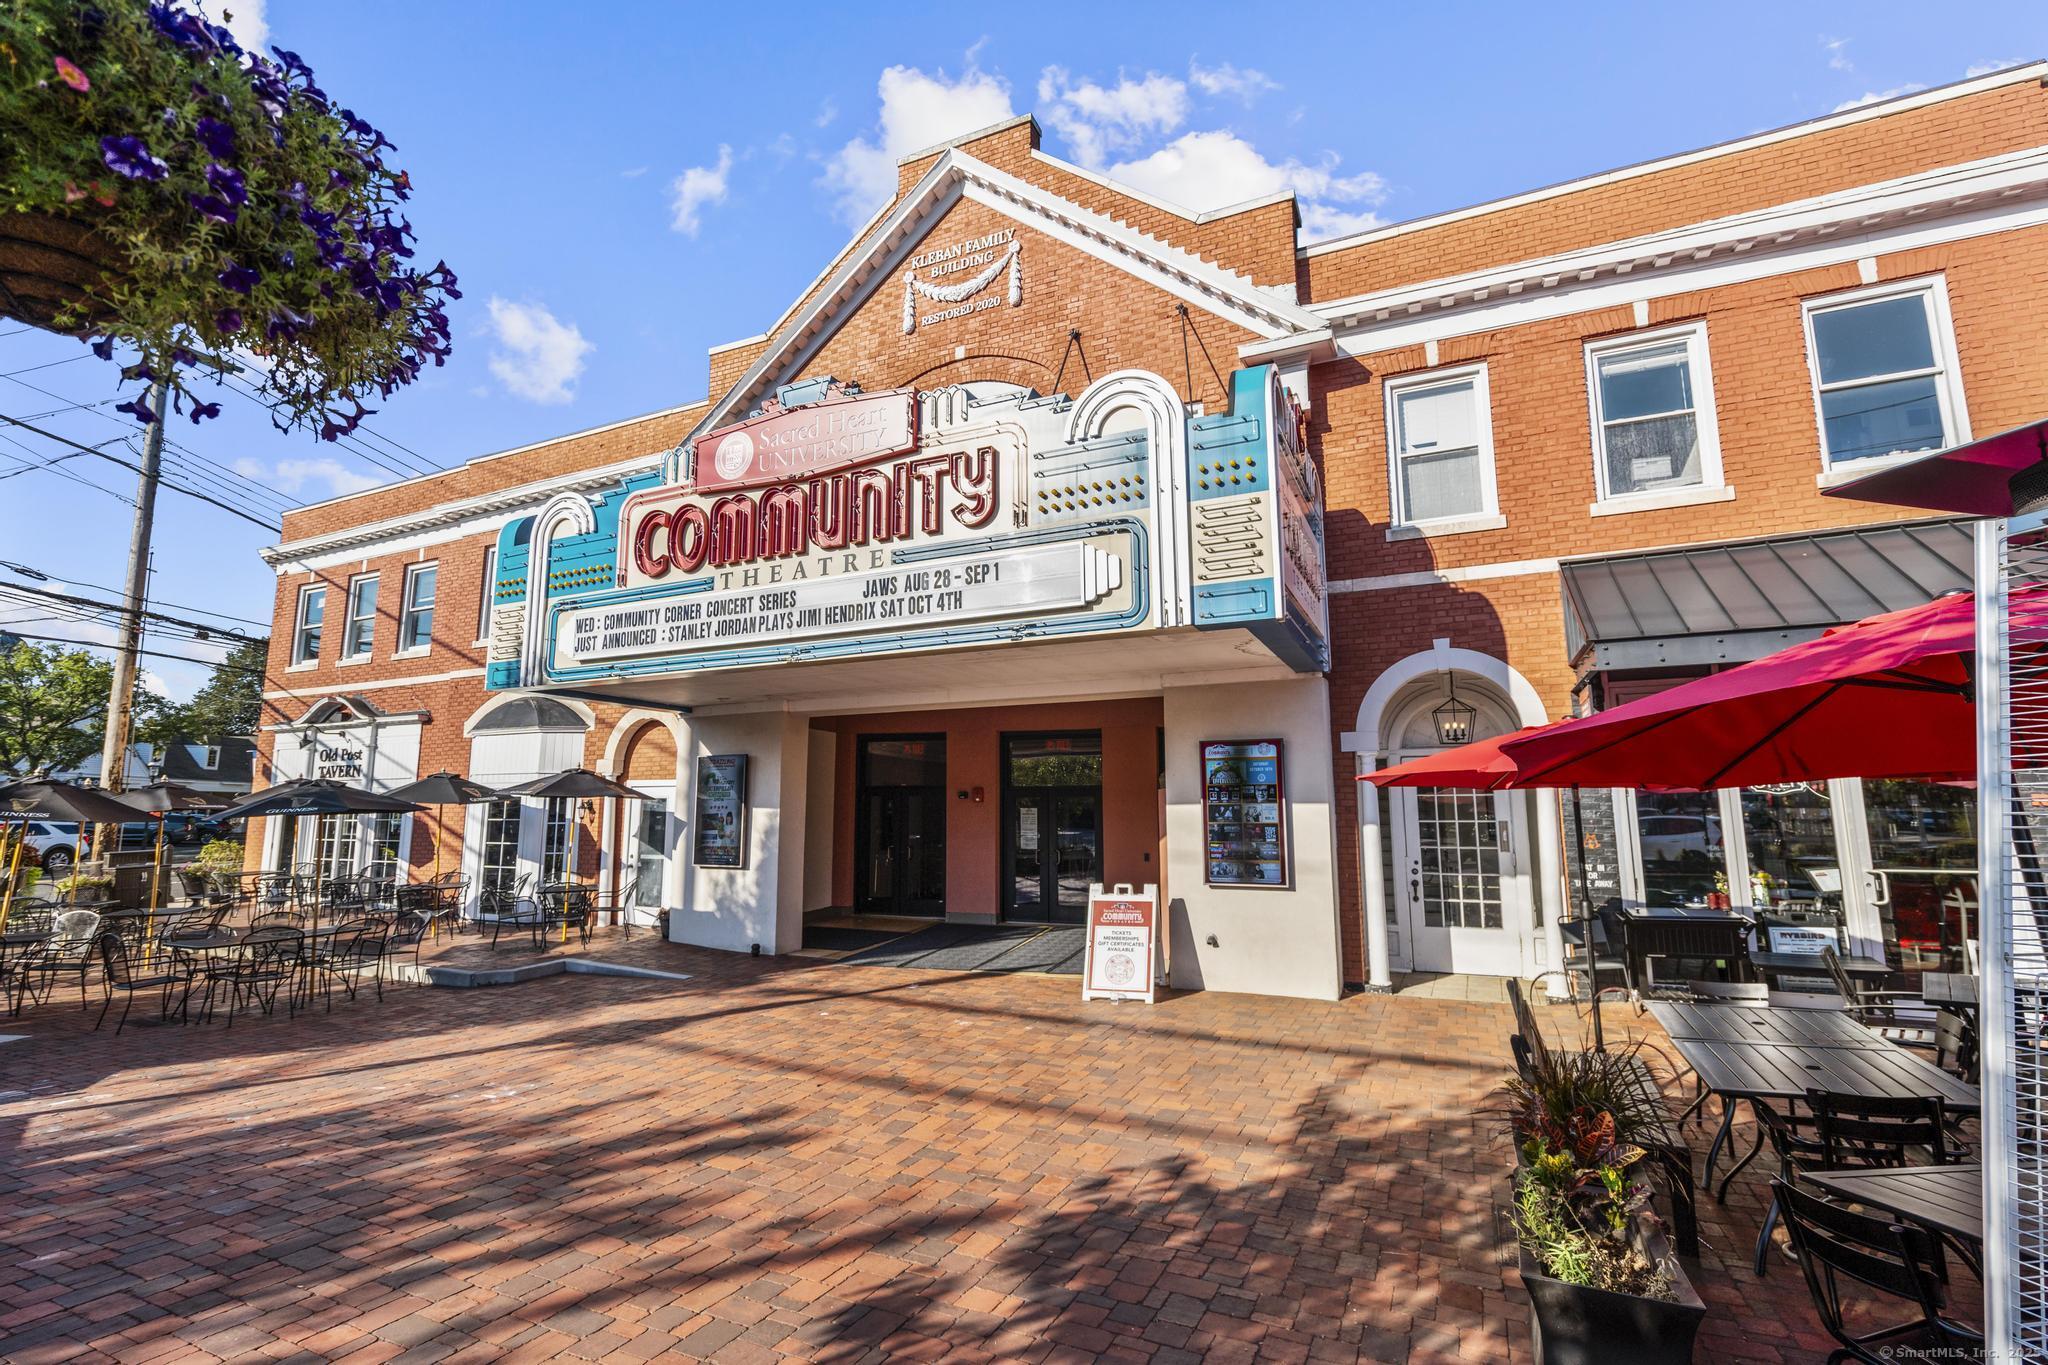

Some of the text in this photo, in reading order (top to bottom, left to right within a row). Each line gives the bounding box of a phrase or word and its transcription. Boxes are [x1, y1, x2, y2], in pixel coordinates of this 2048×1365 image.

[911, 228, 1016, 270] KLEBAN FAMILY
[931, 250, 995, 278] BUILDING
[921, 296, 1001, 327] RESTORED 2020
[759, 406, 887, 450] Sacred Heart
[759, 428, 887, 472] UNIVERSITY
[634, 446, 1001, 578] COMMUNITY
[720, 549, 886, 590] THEATRE
[863, 576, 898, 598] JAWS
[904, 572, 930, 593] AUG
[933, 569, 951, 589] 28
[965, 563, 990, 585] SEP
[993, 562, 999, 581] 1
[574, 635, 598, 653] JUST
[602, 629, 657, 650] ANNOUNCED
[668, 622, 712, 643] STANLEY
[714, 616, 757, 640] JORDAN
[758, 611, 794, 633] PLAYS
[796, 608, 822, 628] JIMI
[825, 600, 876, 625] HENDRIX
[880, 598, 905, 619] SAT
[908, 594, 934, 615] OCT
[936, 590, 963, 612] 4TH
[604, 608, 661, 631] COMMUNITY
[664, 603, 701, 623] CORNER
[706, 597, 755, 618] CONCERT
[759, 590, 797, 612] SERIES
[318, 764, 362, 778] TAVERN
[320, 748, 363, 762] Old Post
[1594, 880, 1613, 888] AWAY
[1780, 932, 1826, 940] RYEBIRD
